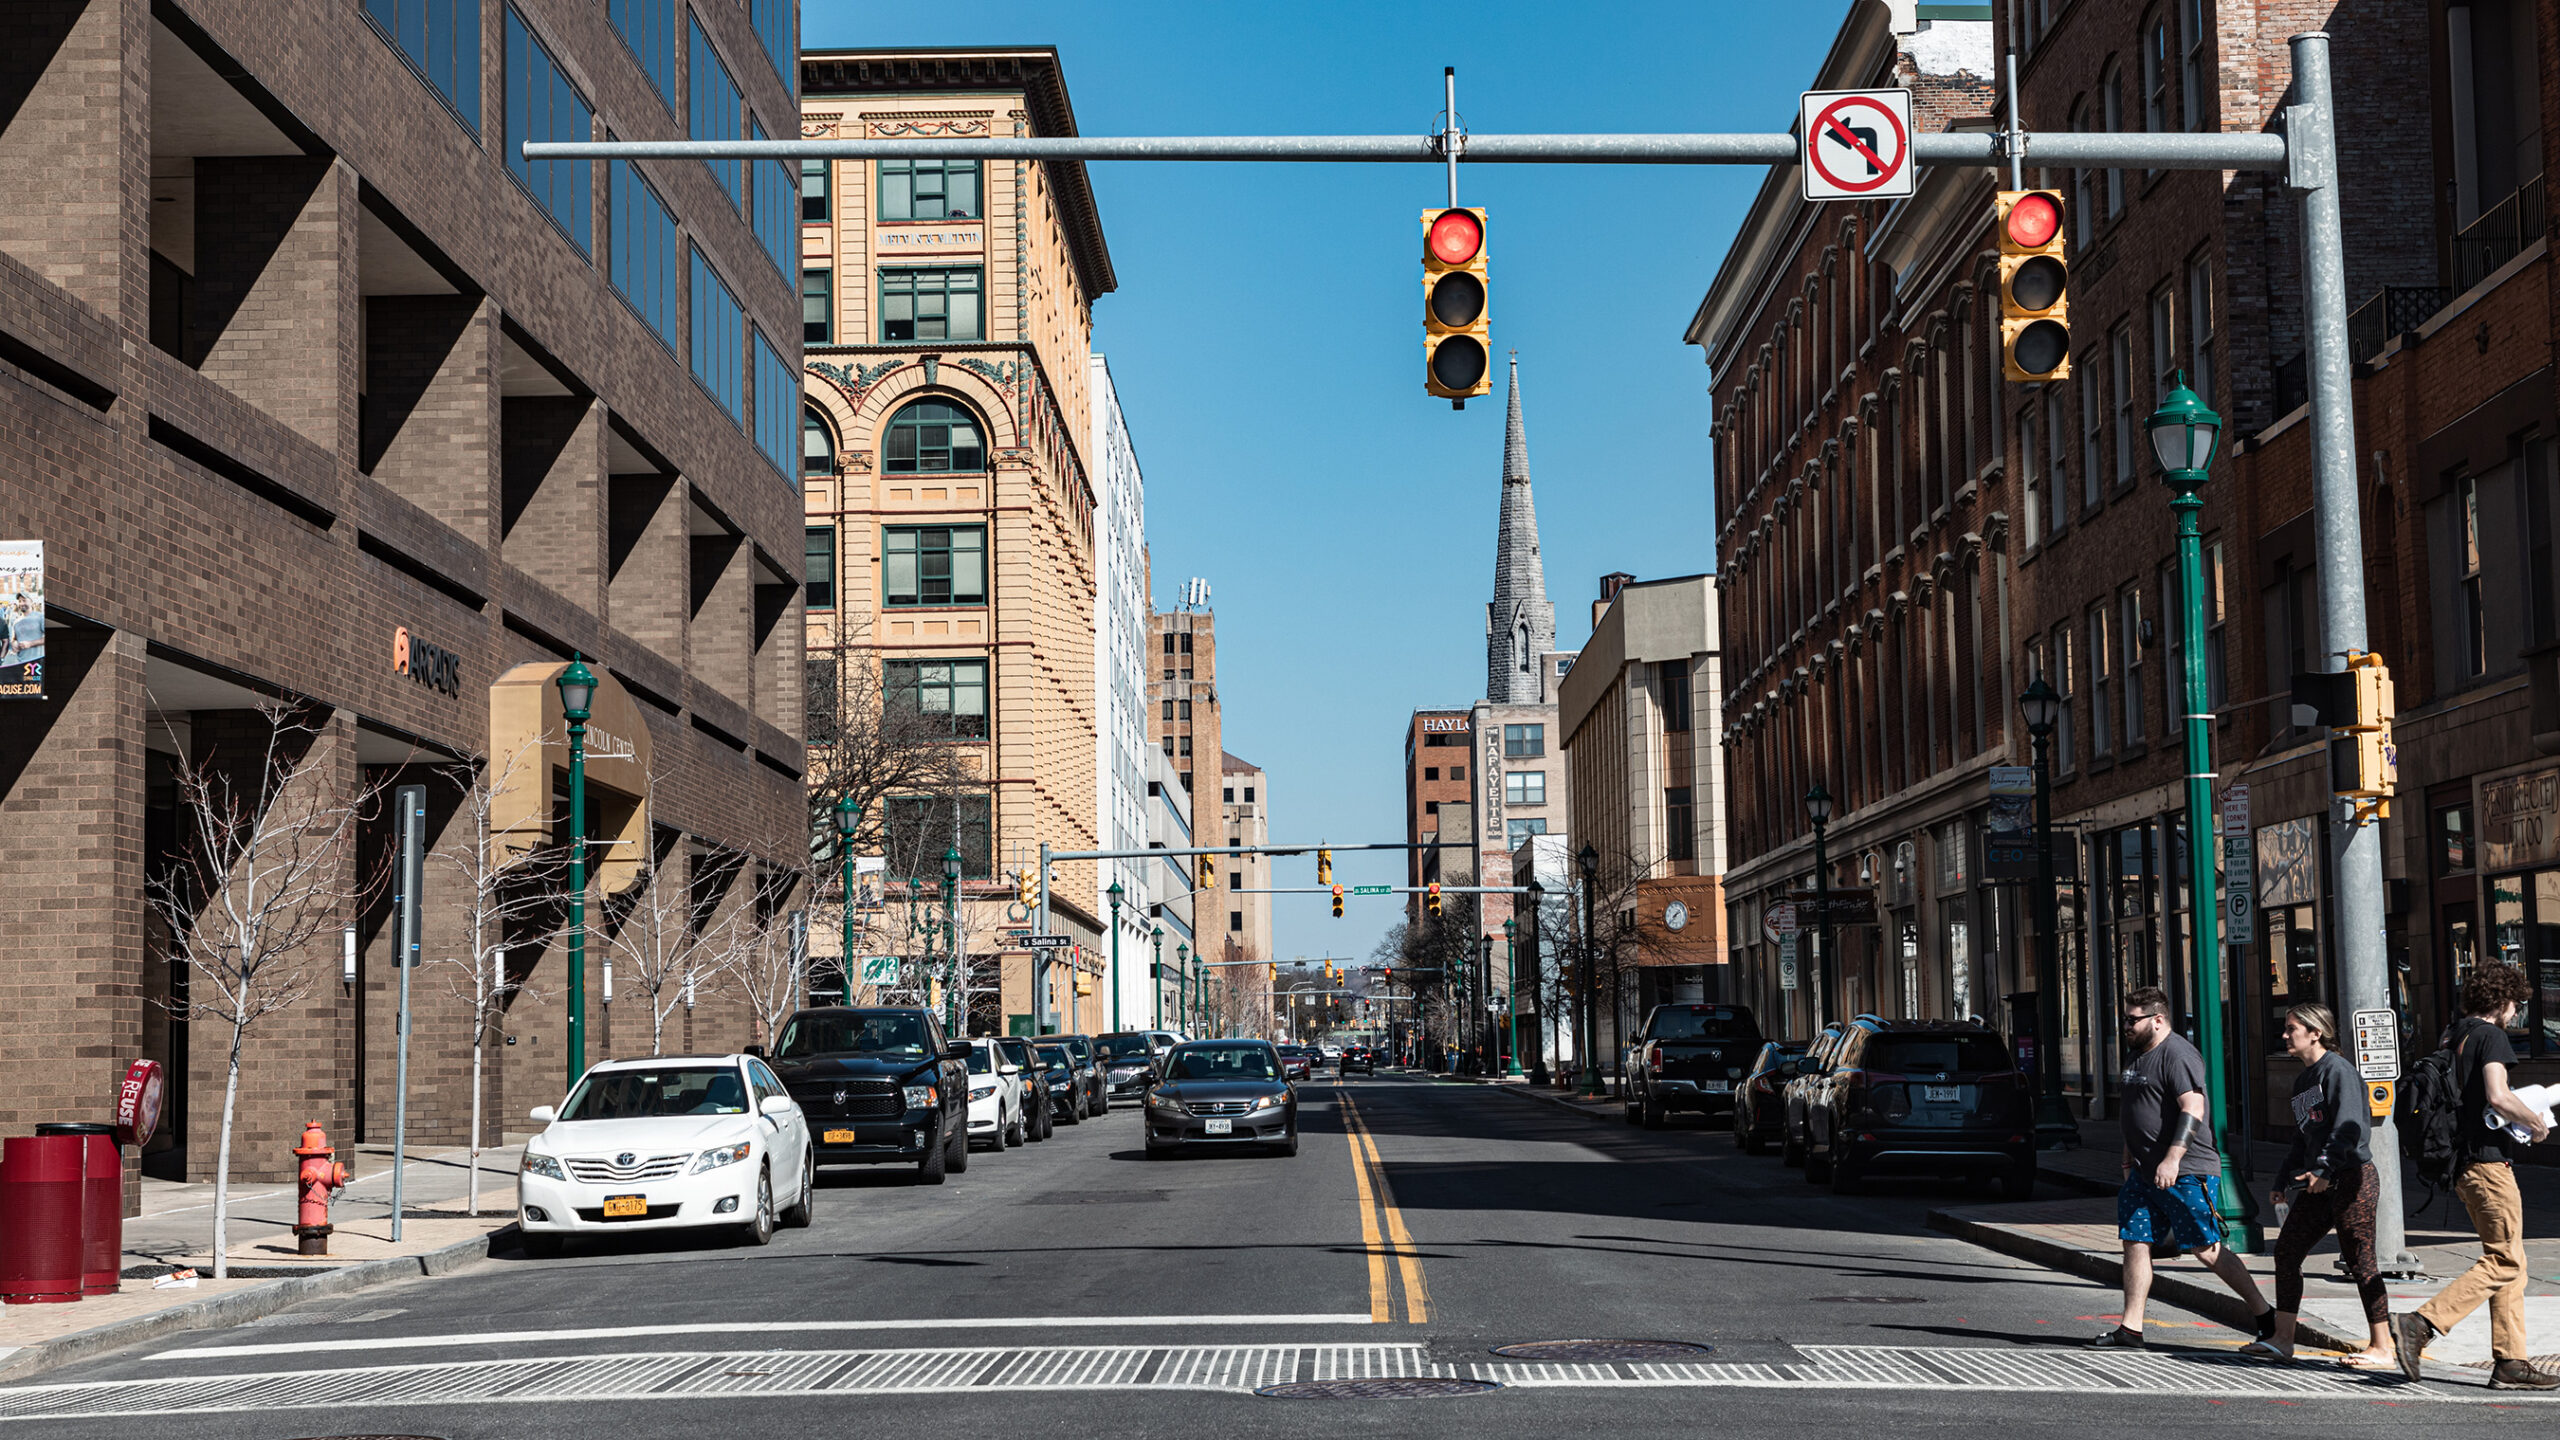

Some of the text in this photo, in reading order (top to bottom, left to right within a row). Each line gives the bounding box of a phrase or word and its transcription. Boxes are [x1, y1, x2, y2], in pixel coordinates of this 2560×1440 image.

[878, 232, 982, 246] MELVIN & MELVIN
[23, 662, 42, 676] SYR
[408, 635, 460, 695] ARCADIS
[583, 722, 610, 753] LINCOLN
[1487, 737, 1500, 828] LAFAYETTE
[2482, 775, 2559, 826] RESURRECTED
[2225, 804, 2239, 812] HERE
[2226, 814, 2247, 822] CORNER
[2502, 815, 2544, 849] TATTOO
[2226, 842, 2232, 855] 2
[2234, 918, 2244, 926] PAY
[2237, 924, 2250, 933] PARK
[1031, 937, 1057, 946] Salina
[887, 958, 896, 970] 2
[118, 1079, 141, 1127] REUSE
